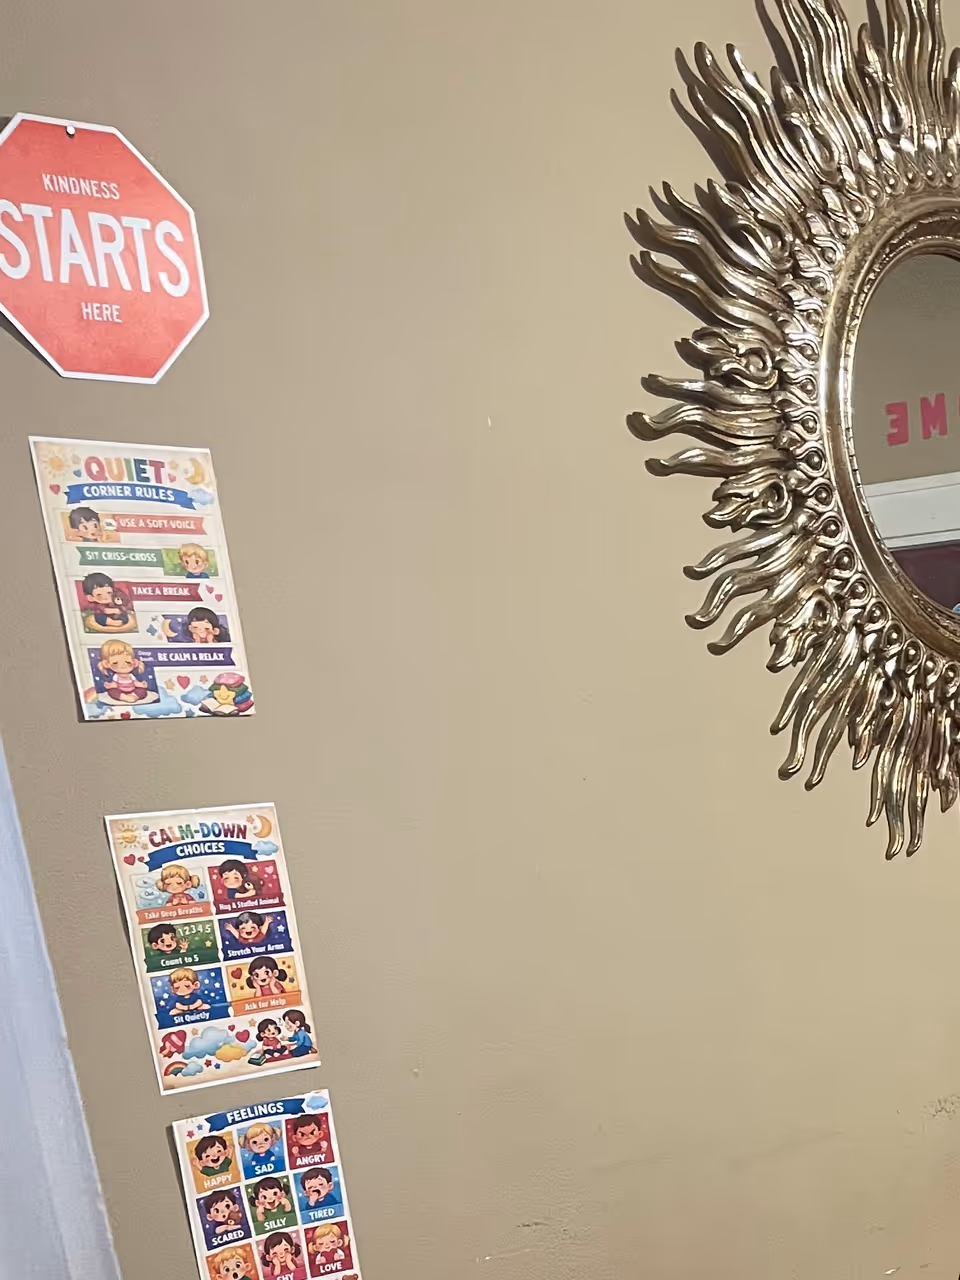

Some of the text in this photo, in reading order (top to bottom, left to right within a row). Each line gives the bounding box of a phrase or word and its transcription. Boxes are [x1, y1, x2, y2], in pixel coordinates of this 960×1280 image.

[42, 173, 120, 200] KINDNESS
[0, 199, 190, 297] STARTS
[81, 301, 122, 323] HERE
[84, 456, 165, 484] QUIET
[83, 485, 175, 501] CORNER RULES
[120, 518, 136, 527] USE
[139, 519, 145, 527] A
[86, 551, 157, 562] SIT CRISS-CROSS
[132, 587, 190, 596] TAKE A BREAK
[157, 653, 168, 661] BE
[169, 653, 190, 661] CALM
[199, 653, 225, 661] RELAX
[148, 822, 248, 847] CALM-DOWN
[176, 842, 225, 856] CHOICES
[219, 902, 231, 911] Hug
[144, 912, 160, 920] Take
[228, 943, 284, 958] Stretch Your Arms
[161, 958, 183, 967] Count
[194, 954, 199, 962] 5
[245, 998, 286, 1011] Ask for Help
[174, 1012, 210, 1024] Sit Quietly
[226, 1102, 285, 1124] FEELINGS
[296, 1154, 326, 1166] ANGRY
[255, 1163, 275, 1175] SAD
[204, 1173, 232, 1189] HAPPY
[308, 1208, 335, 1220] TIRED
[264, 1218, 287, 1231] SILLY
[212, 1230, 244, 1246] SCARED
[319, 1262, 342, 1273] LOVE
